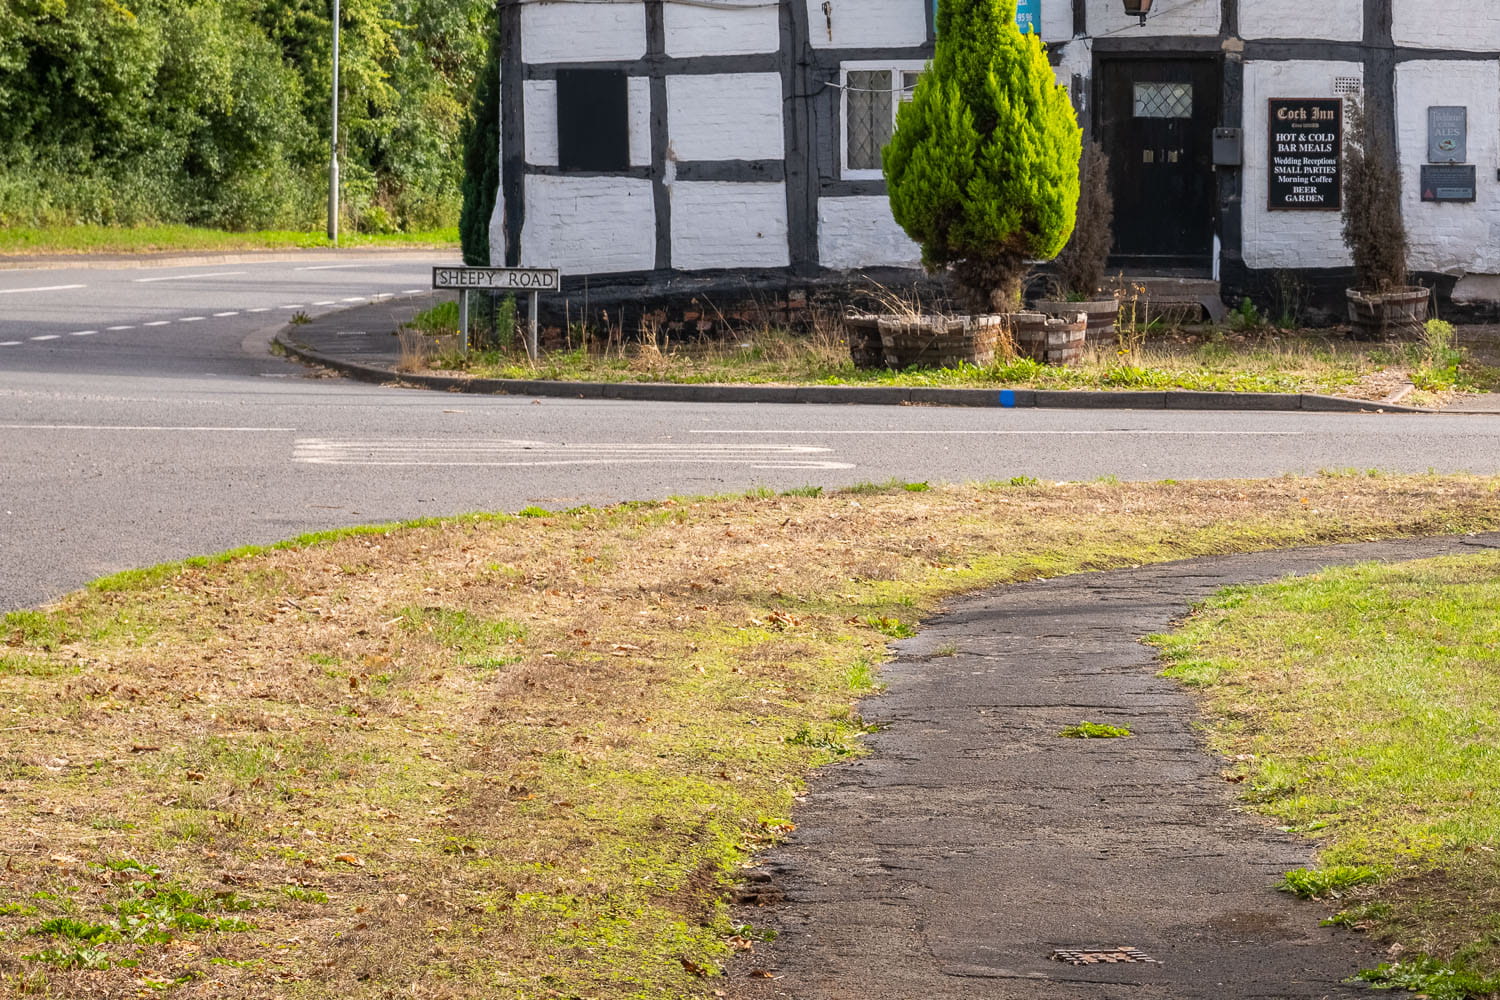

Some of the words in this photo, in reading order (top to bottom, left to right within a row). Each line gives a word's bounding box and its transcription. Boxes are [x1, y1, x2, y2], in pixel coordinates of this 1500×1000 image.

[1277, 107, 1307, 120] Cock
[1311, 107, 1334, 120] Inn
[1276, 133, 1296, 142] HOT
[1298, 133, 1306, 142] &
[1308, 133, 1334, 142] COLD
[1278, 144, 1296, 152] BAR
[1299, 144, 1332, 152] MEALS
[1274, 157, 1301, 166] Wedding
[1303, 157, 1336, 166] Receptions
[1278, 175, 1309, 184] Morning
[1310, 175, 1333, 183] Coffee
[440, 271, 496, 285] SHEEPY
[508, 273, 553, 287] ROAD
